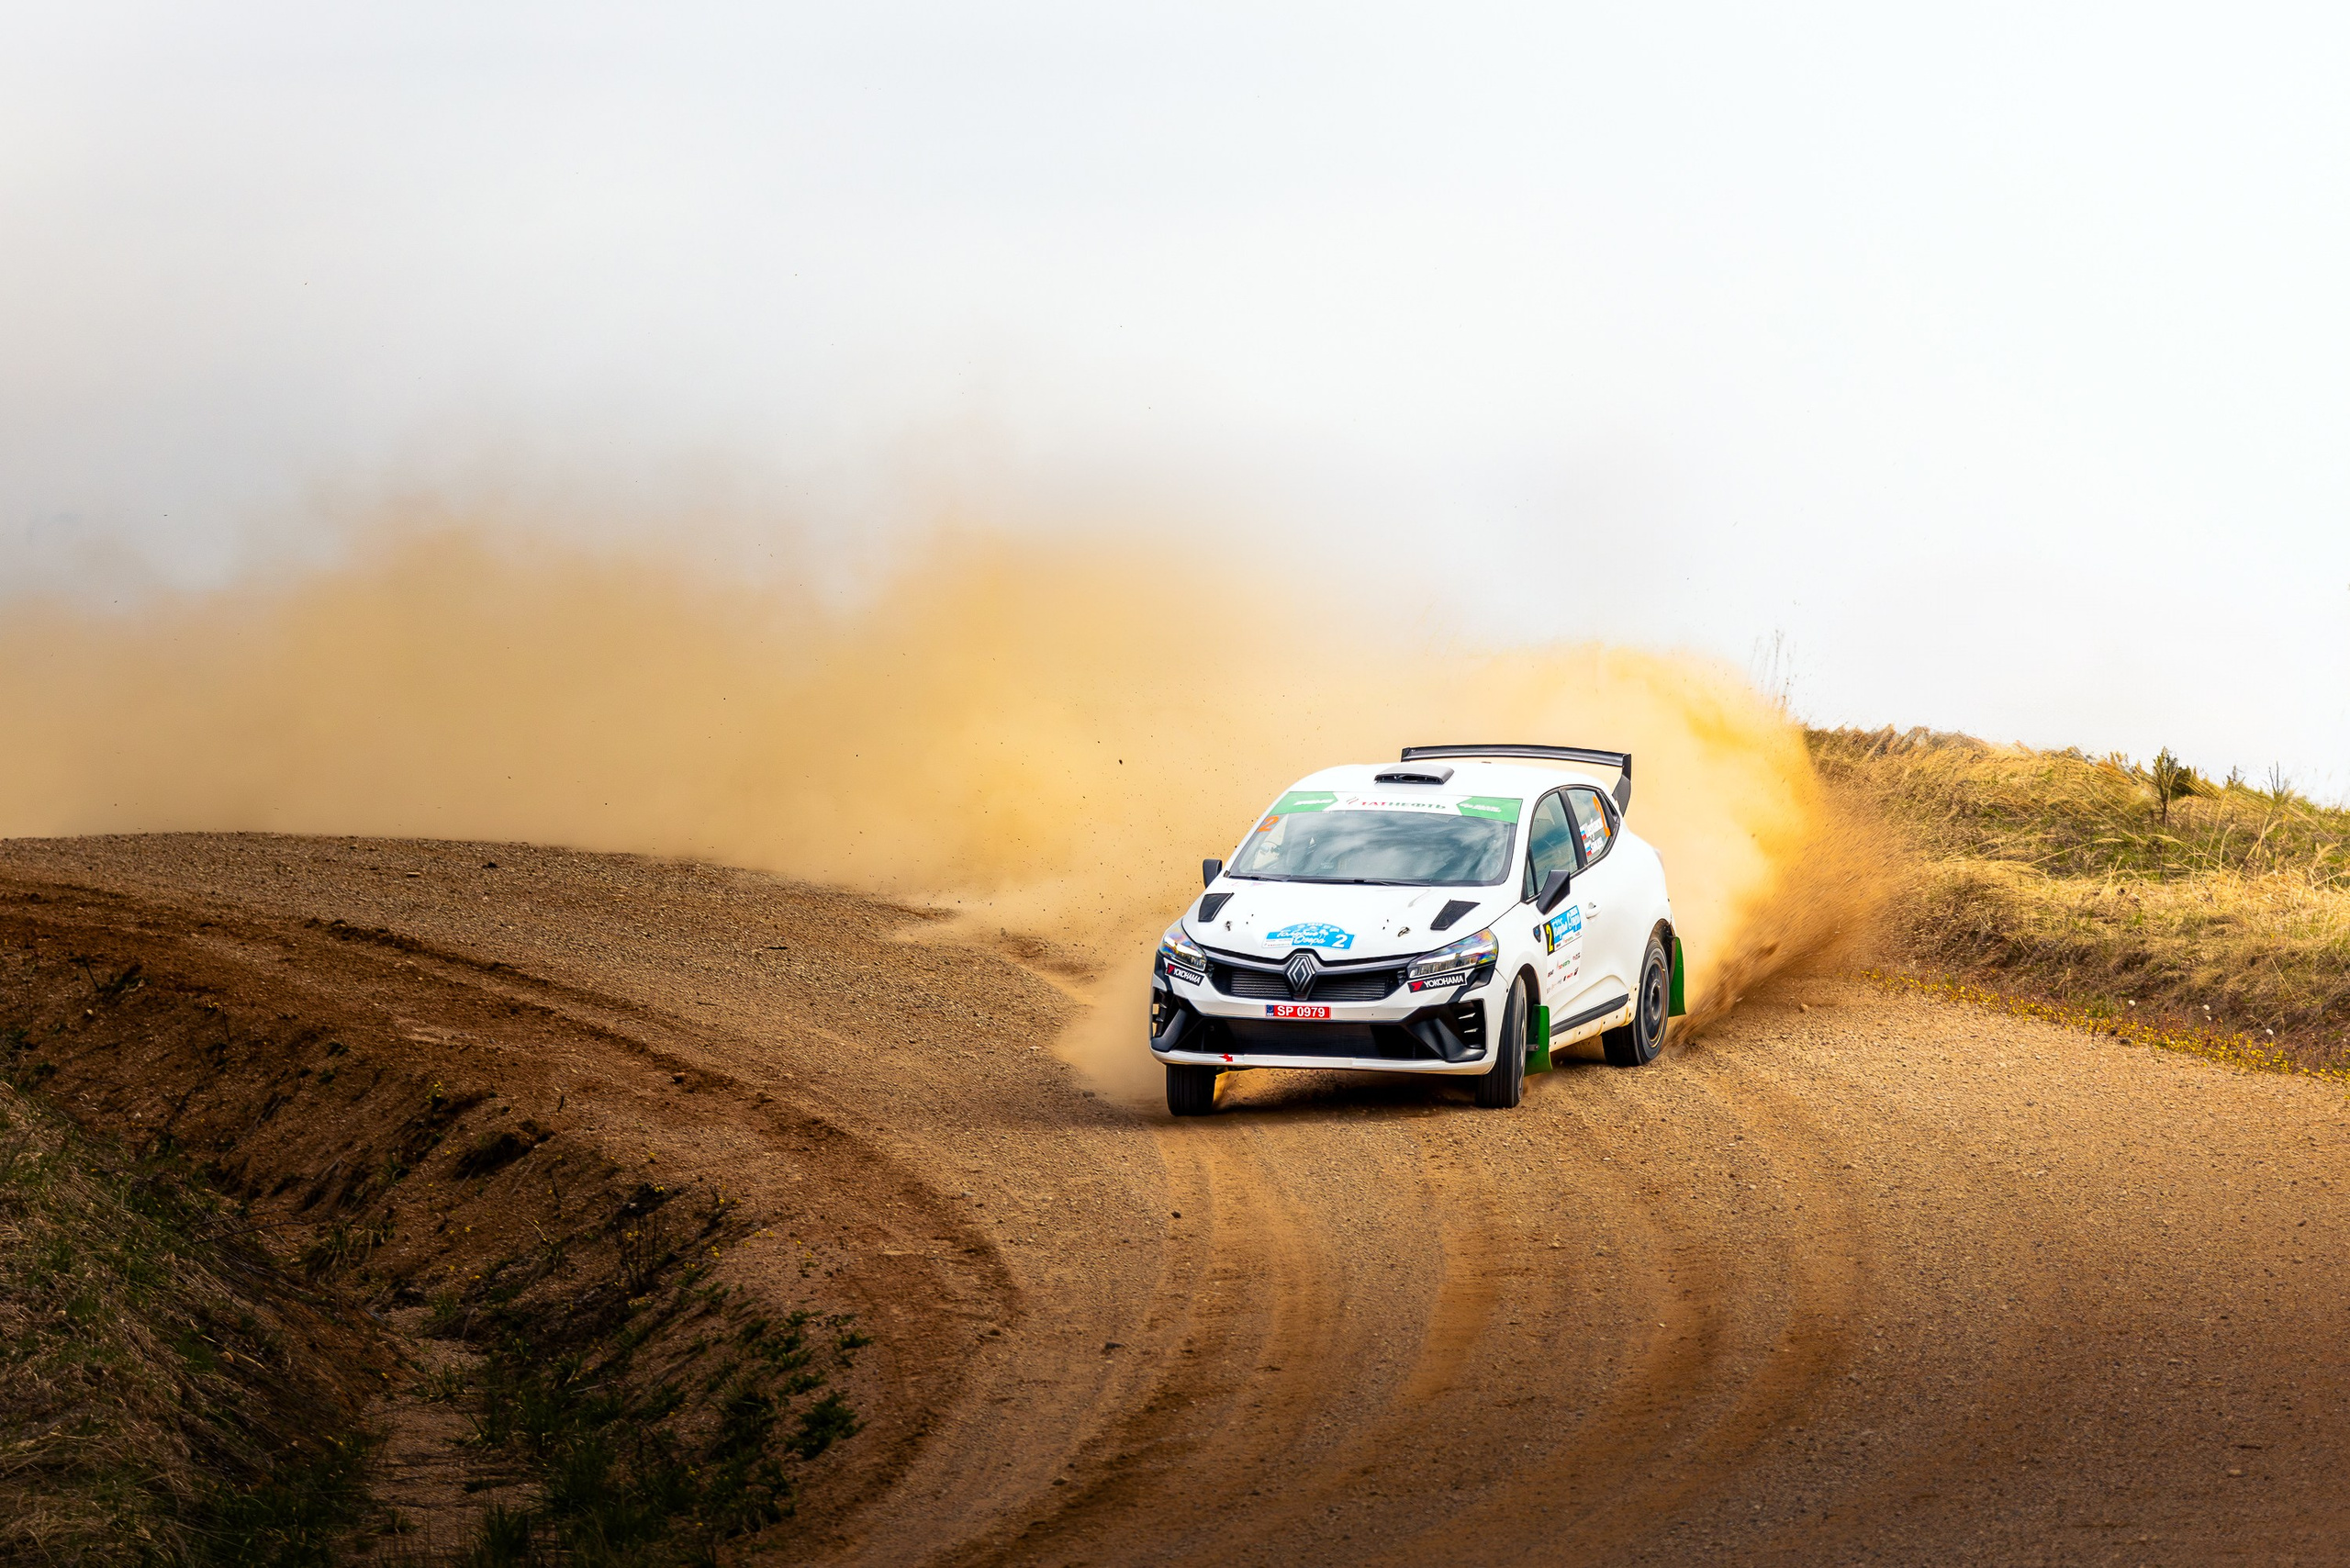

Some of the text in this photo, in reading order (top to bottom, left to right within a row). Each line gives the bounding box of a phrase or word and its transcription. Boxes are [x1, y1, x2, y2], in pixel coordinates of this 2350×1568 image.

[1257, 815, 1280, 833] 2
[1331, 934, 1348, 948] 2
[1546, 924, 1553, 952] 2
[1173, 968, 1201, 984] YOKOHAMA
[1423, 975, 1464, 988] YOKOHAMA
[1277, 1005, 1325, 1018] SP 0979
